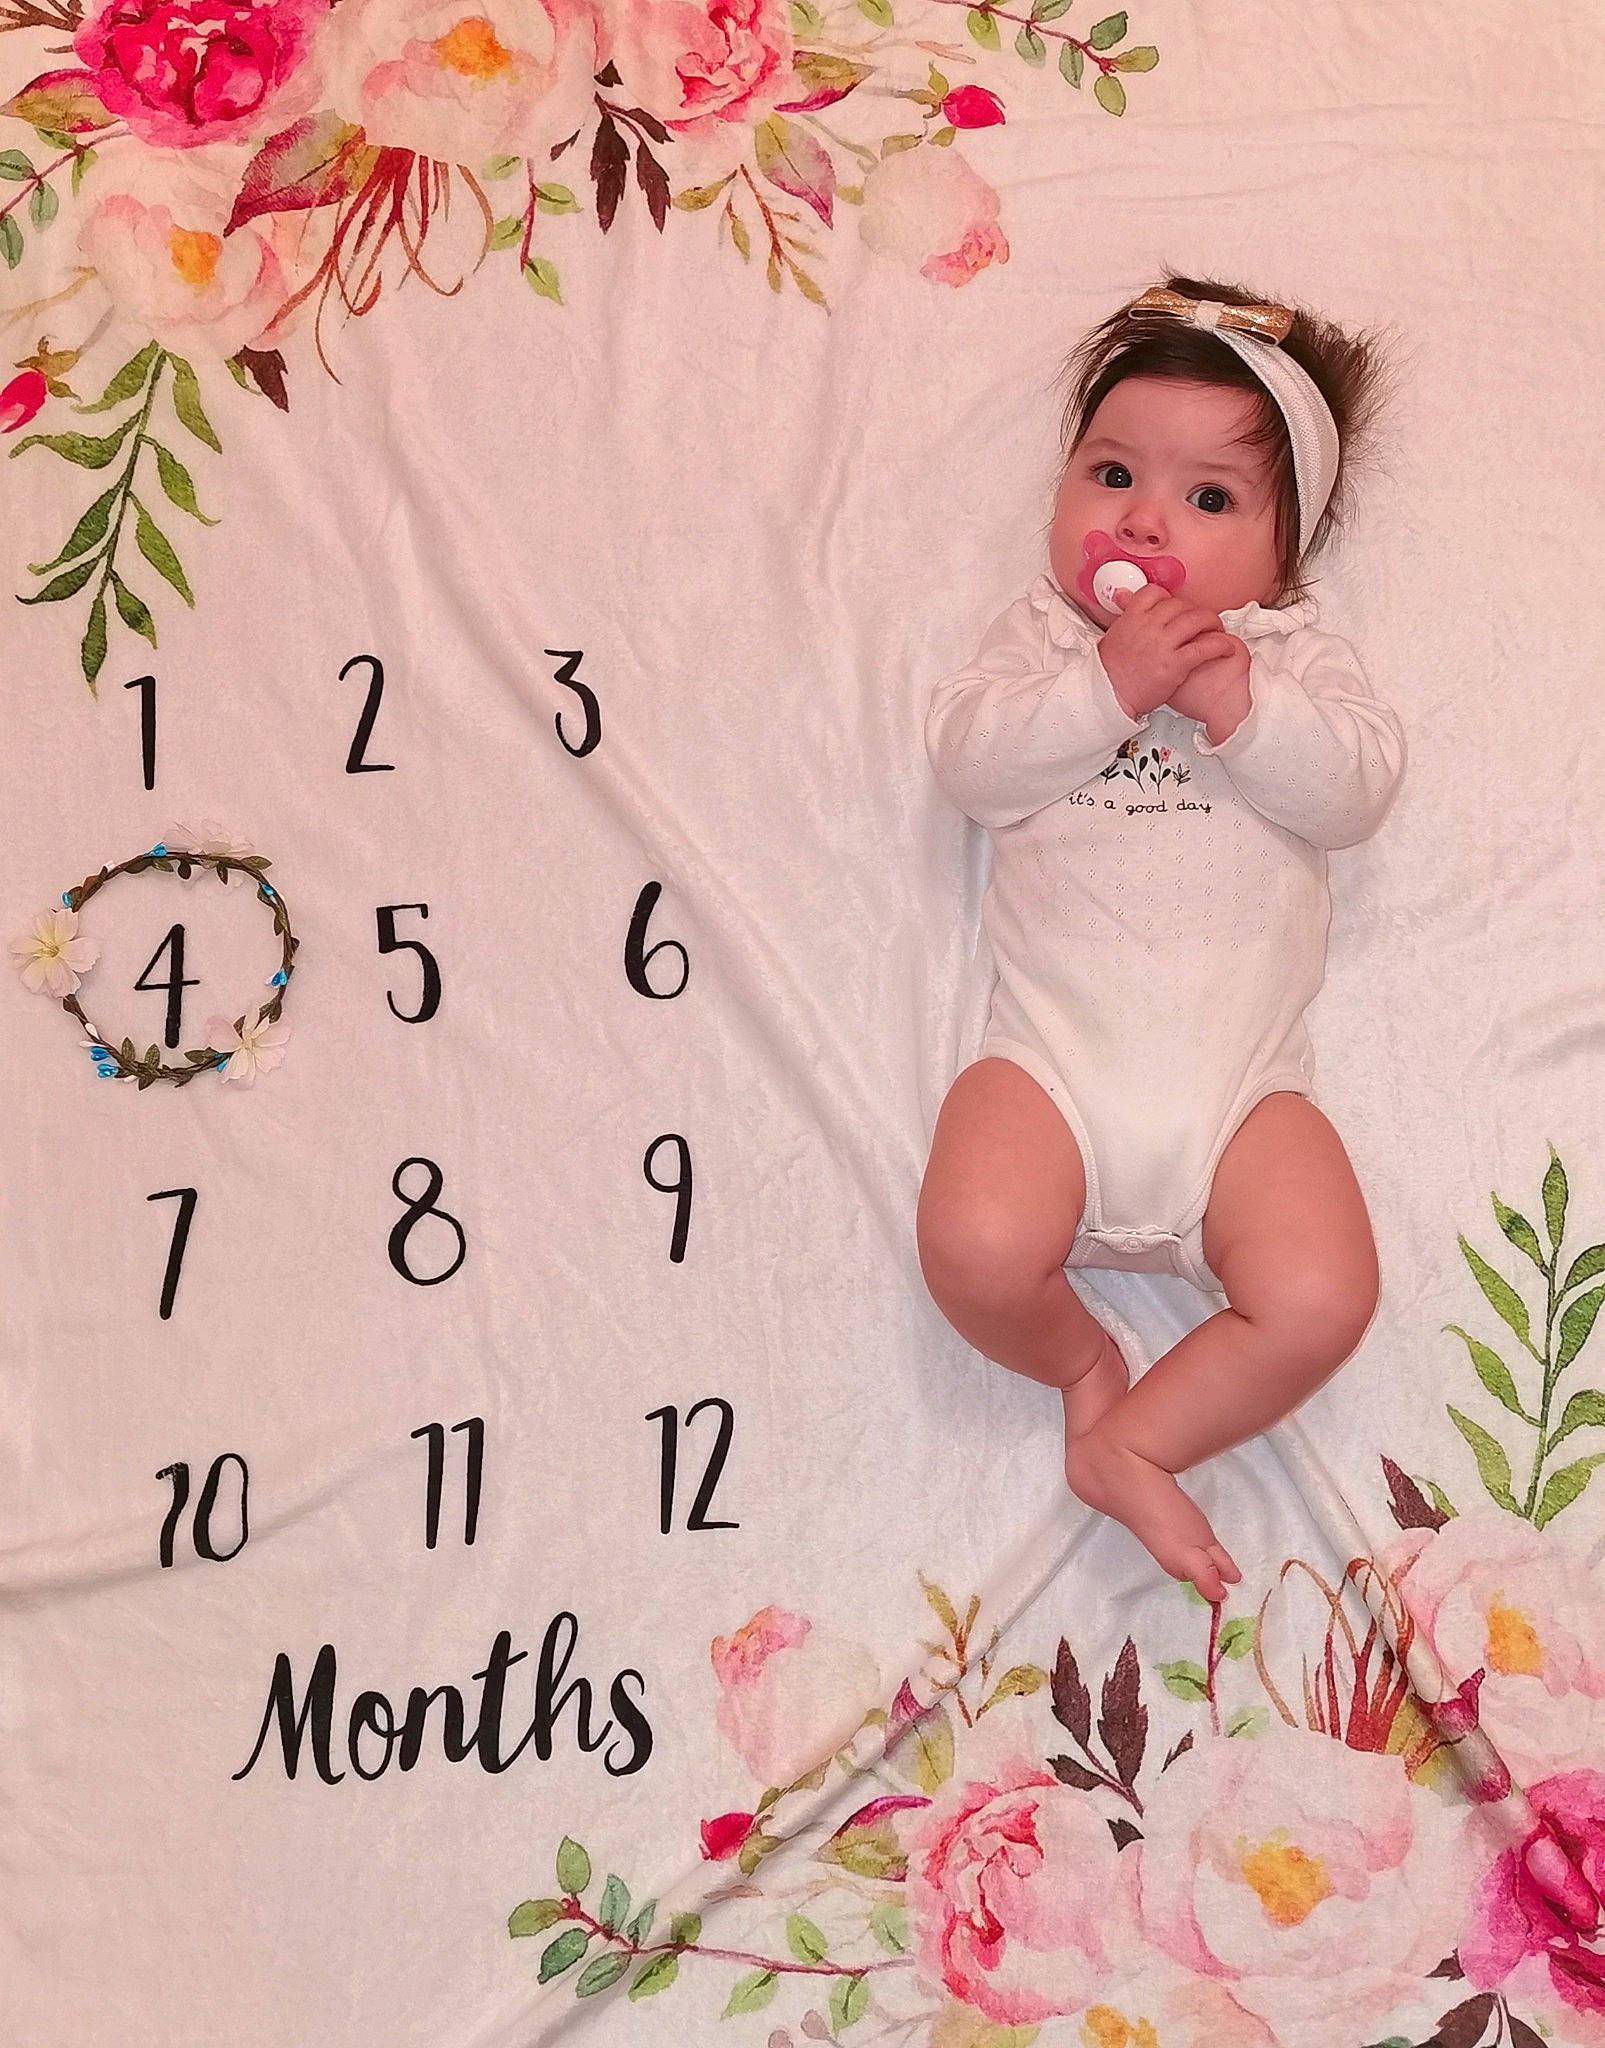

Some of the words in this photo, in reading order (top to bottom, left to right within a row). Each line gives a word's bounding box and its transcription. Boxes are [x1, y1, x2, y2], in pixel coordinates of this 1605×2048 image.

[123, 675, 157, 791] 1
[338, 654, 396, 774] 2
[543, 649, 602, 759] 3
[1068, 792, 1095, 807] it's
[1104, 800, 1116, 809] a
[1125, 800, 1168, 816] good
[1176, 799, 1212, 813] day
[134, 923, 201, 1050] 4
[375, 903, 442, 1025] 5
[624, 880, 690, 1001] 6
[146, 1187, 198, 1321] 7
[387, 1157, 467, 1287] 8
[643, 1133, 693, 1264] 9
[155, 1452, 249, 1569] 10
[410, 1416, 485, 1550] 11
[644, 1397, 740, 1535] 12
[231, 1611, 654, 1786] Months
